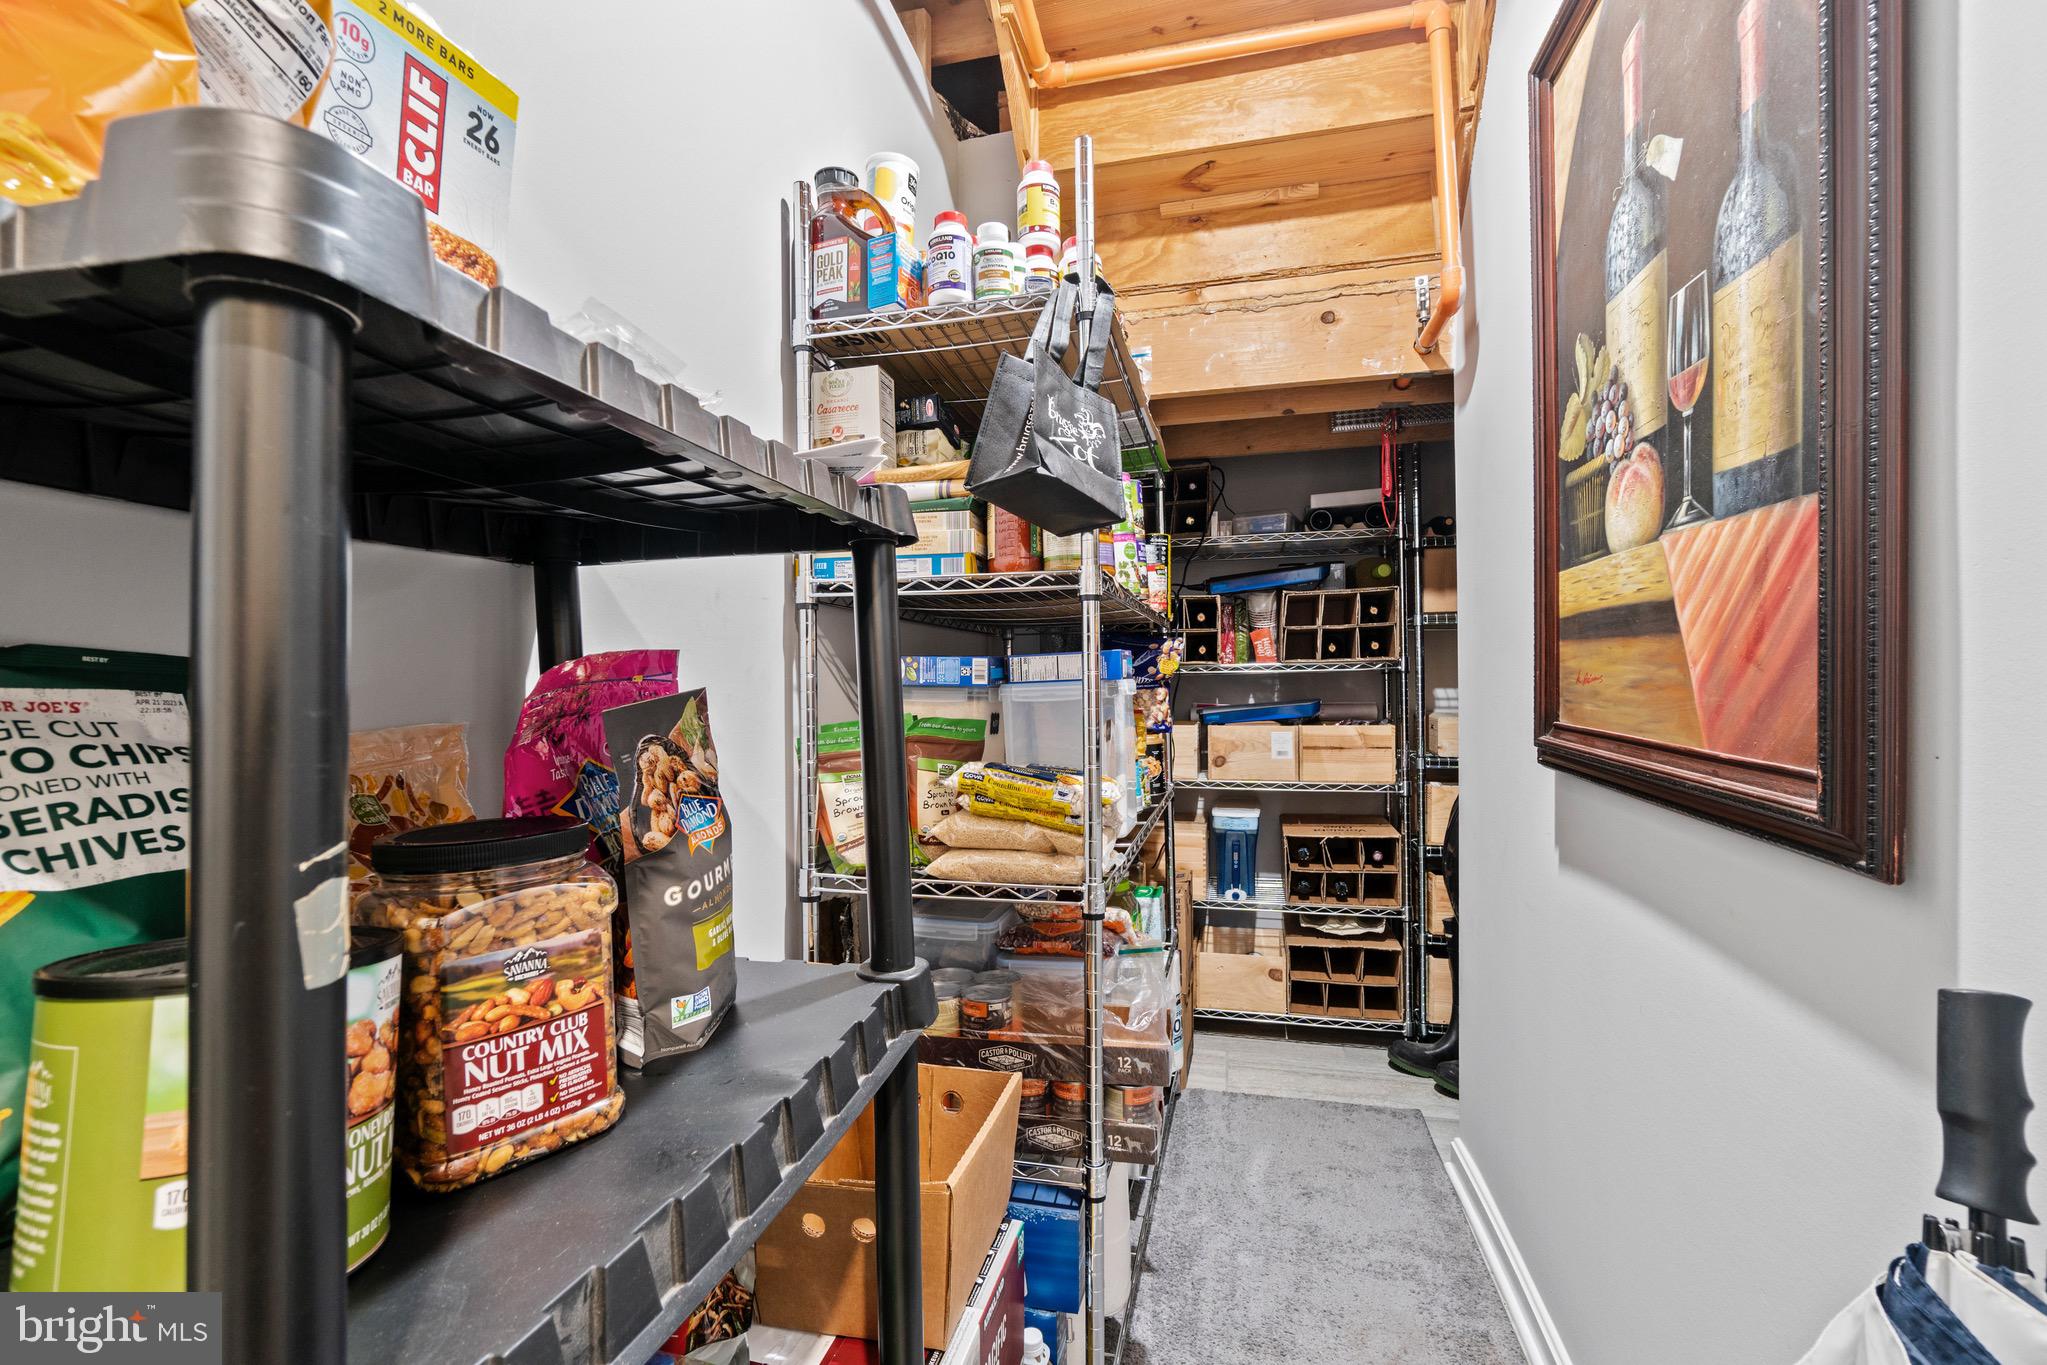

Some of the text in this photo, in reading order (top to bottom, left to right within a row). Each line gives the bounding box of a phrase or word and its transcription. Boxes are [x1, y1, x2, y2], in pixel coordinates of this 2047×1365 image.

[340, 17, 370, 52] 10g
[378, 1, 475, 80] 2 MORE BARS
[294, 69, 314, 93] 160
[340, 80, 362, 98] GMO
[404, 66, 441, 176] CLIF
[477, 105, 494, 121] NOW
[466, 111, 501, 155] 26
[463, 138, 485, 157] ENERGY
[403, 167, 435, 199] BAR
[817, 250, 844, 269] GOLD
[816, 265, 843, 284] PEAK
[816, 403, 859, 415] Casarecce
[24, 701, 82, 714] JOE'S
[48, 719, 120, 738] CUT
[69, 742, 191, 768] CHIPS
[86, 771, 151, 789] WITH
[964, 772, 984, 781] GOYA
[680, 798, 704, 818] BLUE
[923, 801, 948, 810] Brown
[680, 801, 718, 835] DIAMOND
[689, 821, 725, 846] ALMONDS
[1, 824, 186, 875] CHIVES
[663, 860, 733, 907] GOURM
[503, 957, 548, 978] SAVANNA
[462, 1011, 589, 1062] COUNTRY CLUB
[464, 1025, 590, 1087] NUT MIX
[981, 1048, 1004, 1058] CASTOR
[1008, 1048, 1033, 1062] POLLUX
[1117, 1056, 1131, 1068] 12
[463, 1086, 482, 1095] Honey
[458, 1109, 472, 1121] 170
[348, 1115, 381, 1149] ONEY
[478, 1131, 492, 1142] NET
[493, 1127, 506, 1138] WT
[516, 1120, 527, 1130] OZ
[534, 1113, 544, 1123] LB
[1028, 1127, 1052, 1137] CASTOR
[1056, 1127, 1081, 1141] POLLUX
[1107, 1135, 1122, 1147] 12
